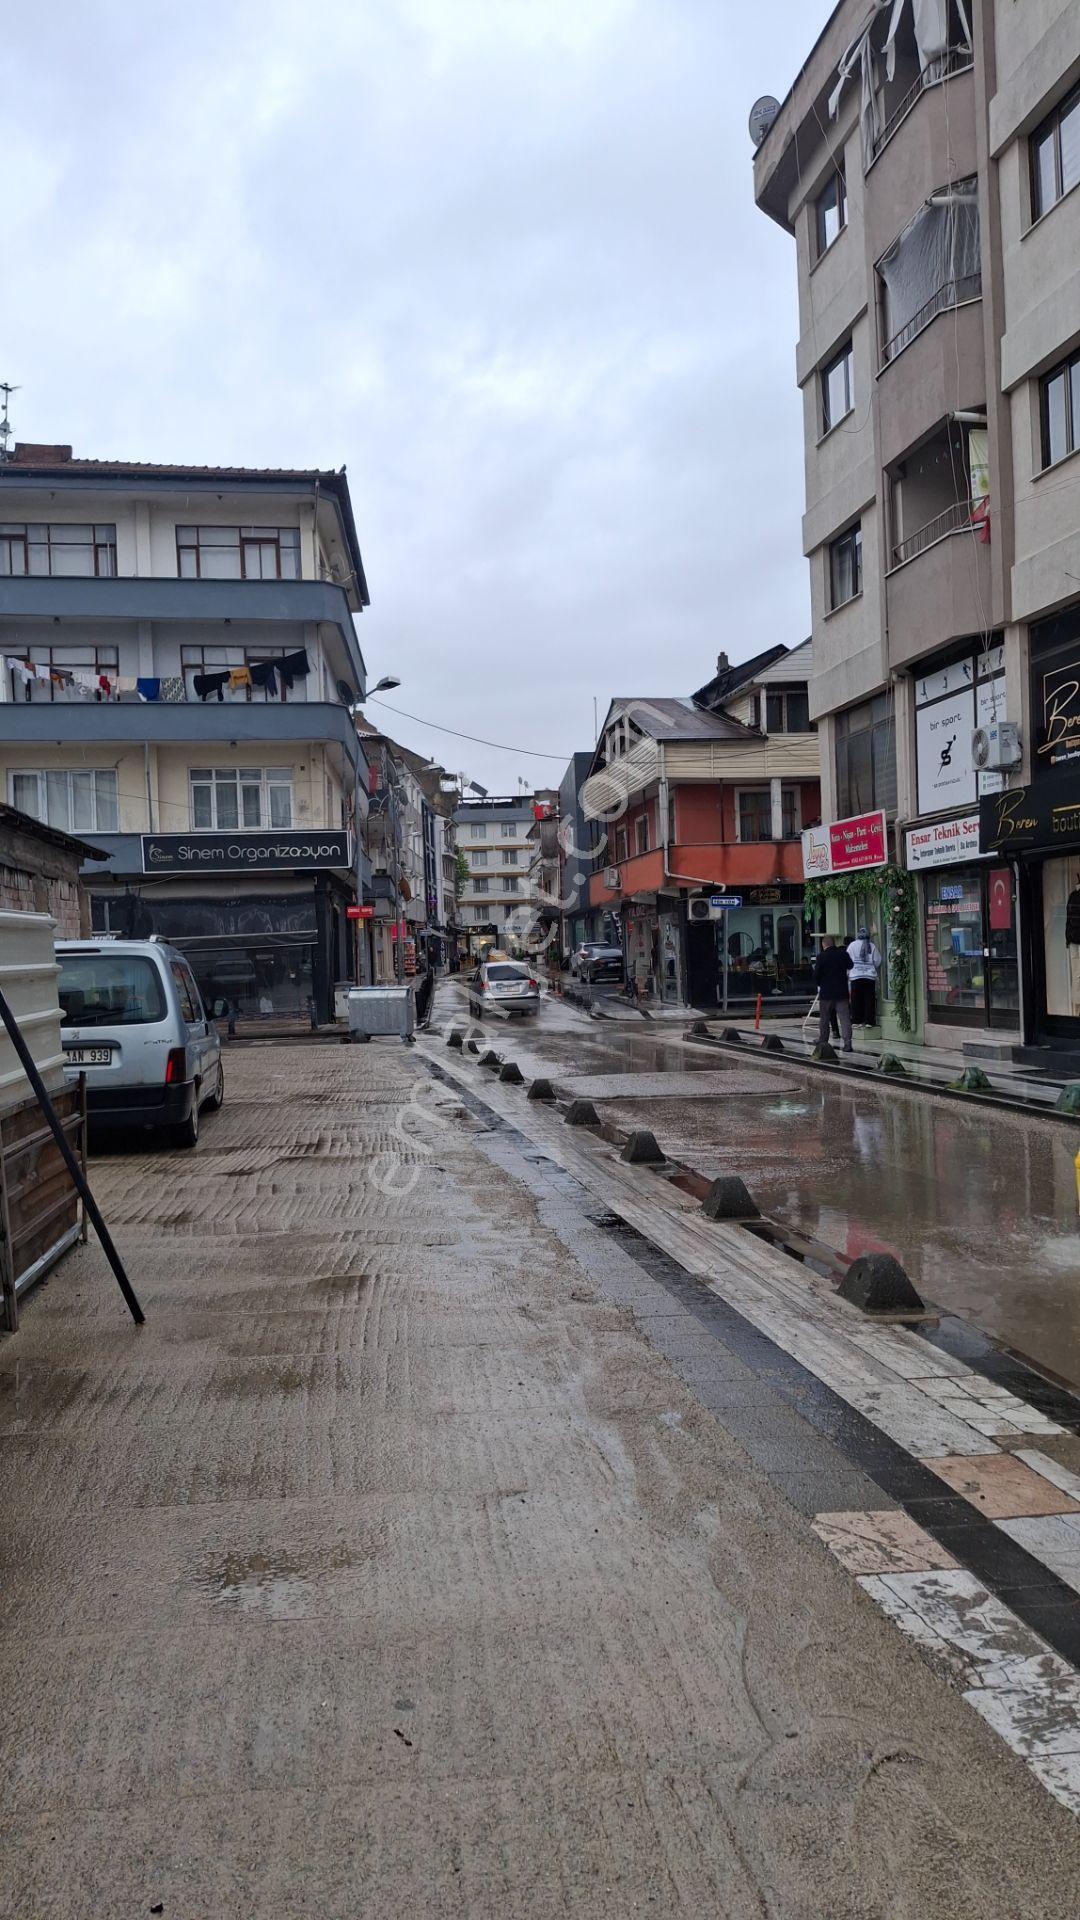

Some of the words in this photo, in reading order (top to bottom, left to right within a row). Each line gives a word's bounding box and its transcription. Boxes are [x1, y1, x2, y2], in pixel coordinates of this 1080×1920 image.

[929, 720, 939, 731] bir
[942, 713, 962, 728] sport
[988, 789, 1038, 849] Beren
[911, 833, 931, 846] Ensar
[933, 822, 960, 841] Teknik
[178, 846, 224, 860] Sinem
[91, 1049, 109, 1062] 939
